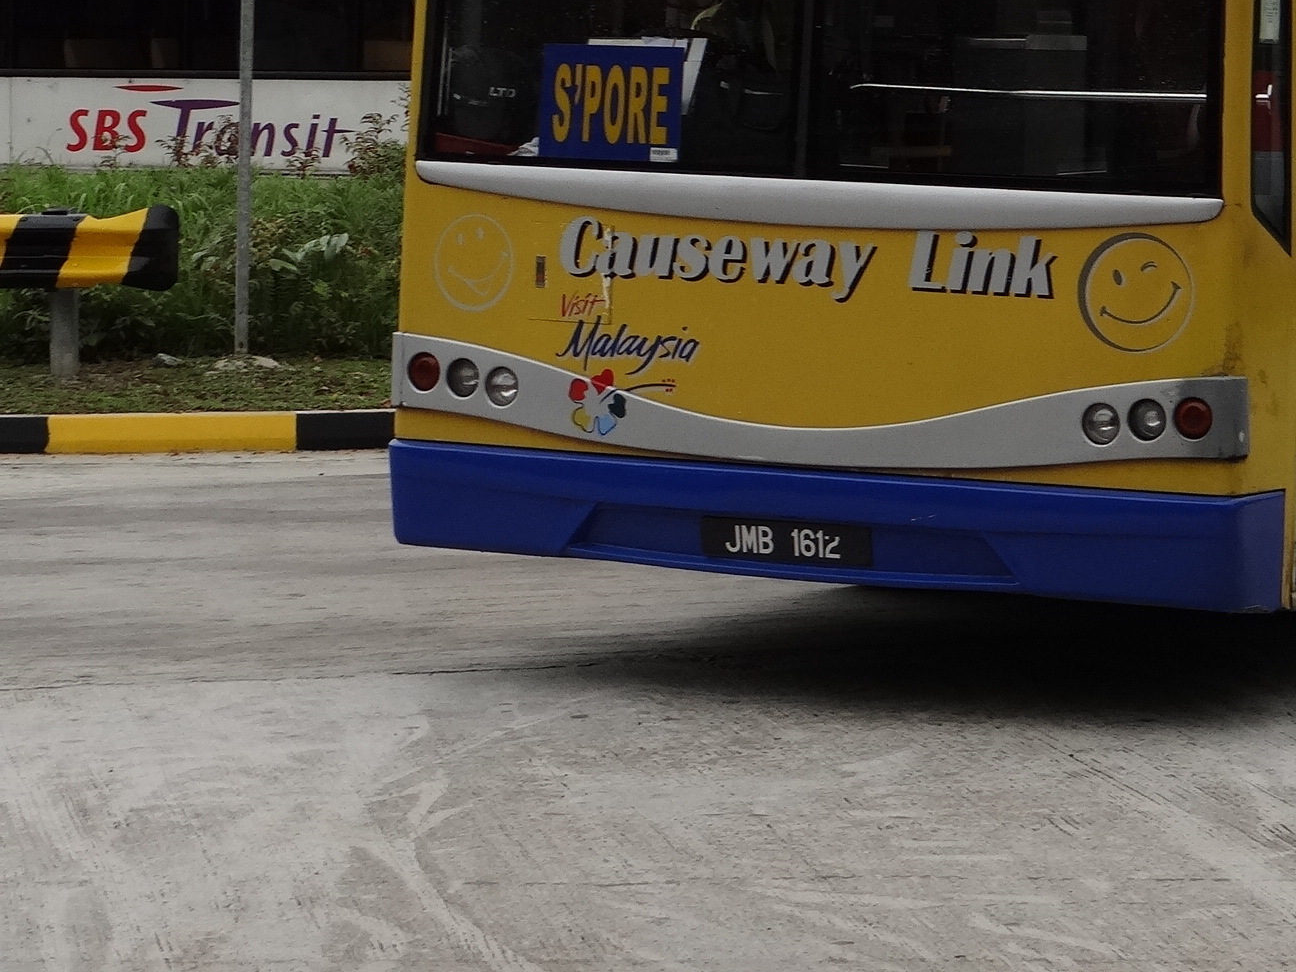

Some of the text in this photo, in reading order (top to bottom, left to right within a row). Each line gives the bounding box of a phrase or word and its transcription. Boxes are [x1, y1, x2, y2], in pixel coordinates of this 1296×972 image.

[66, 99, 356, 158] SBS Transit
[552, 63, 670, 145] S'PORE
[559, 216, 1059, 303] Causeway Link
[558, 292, 606, 318] Visit
[555, 315, 700, 375] Malaysia
[725, 525, 841, 559] JMB 1612
